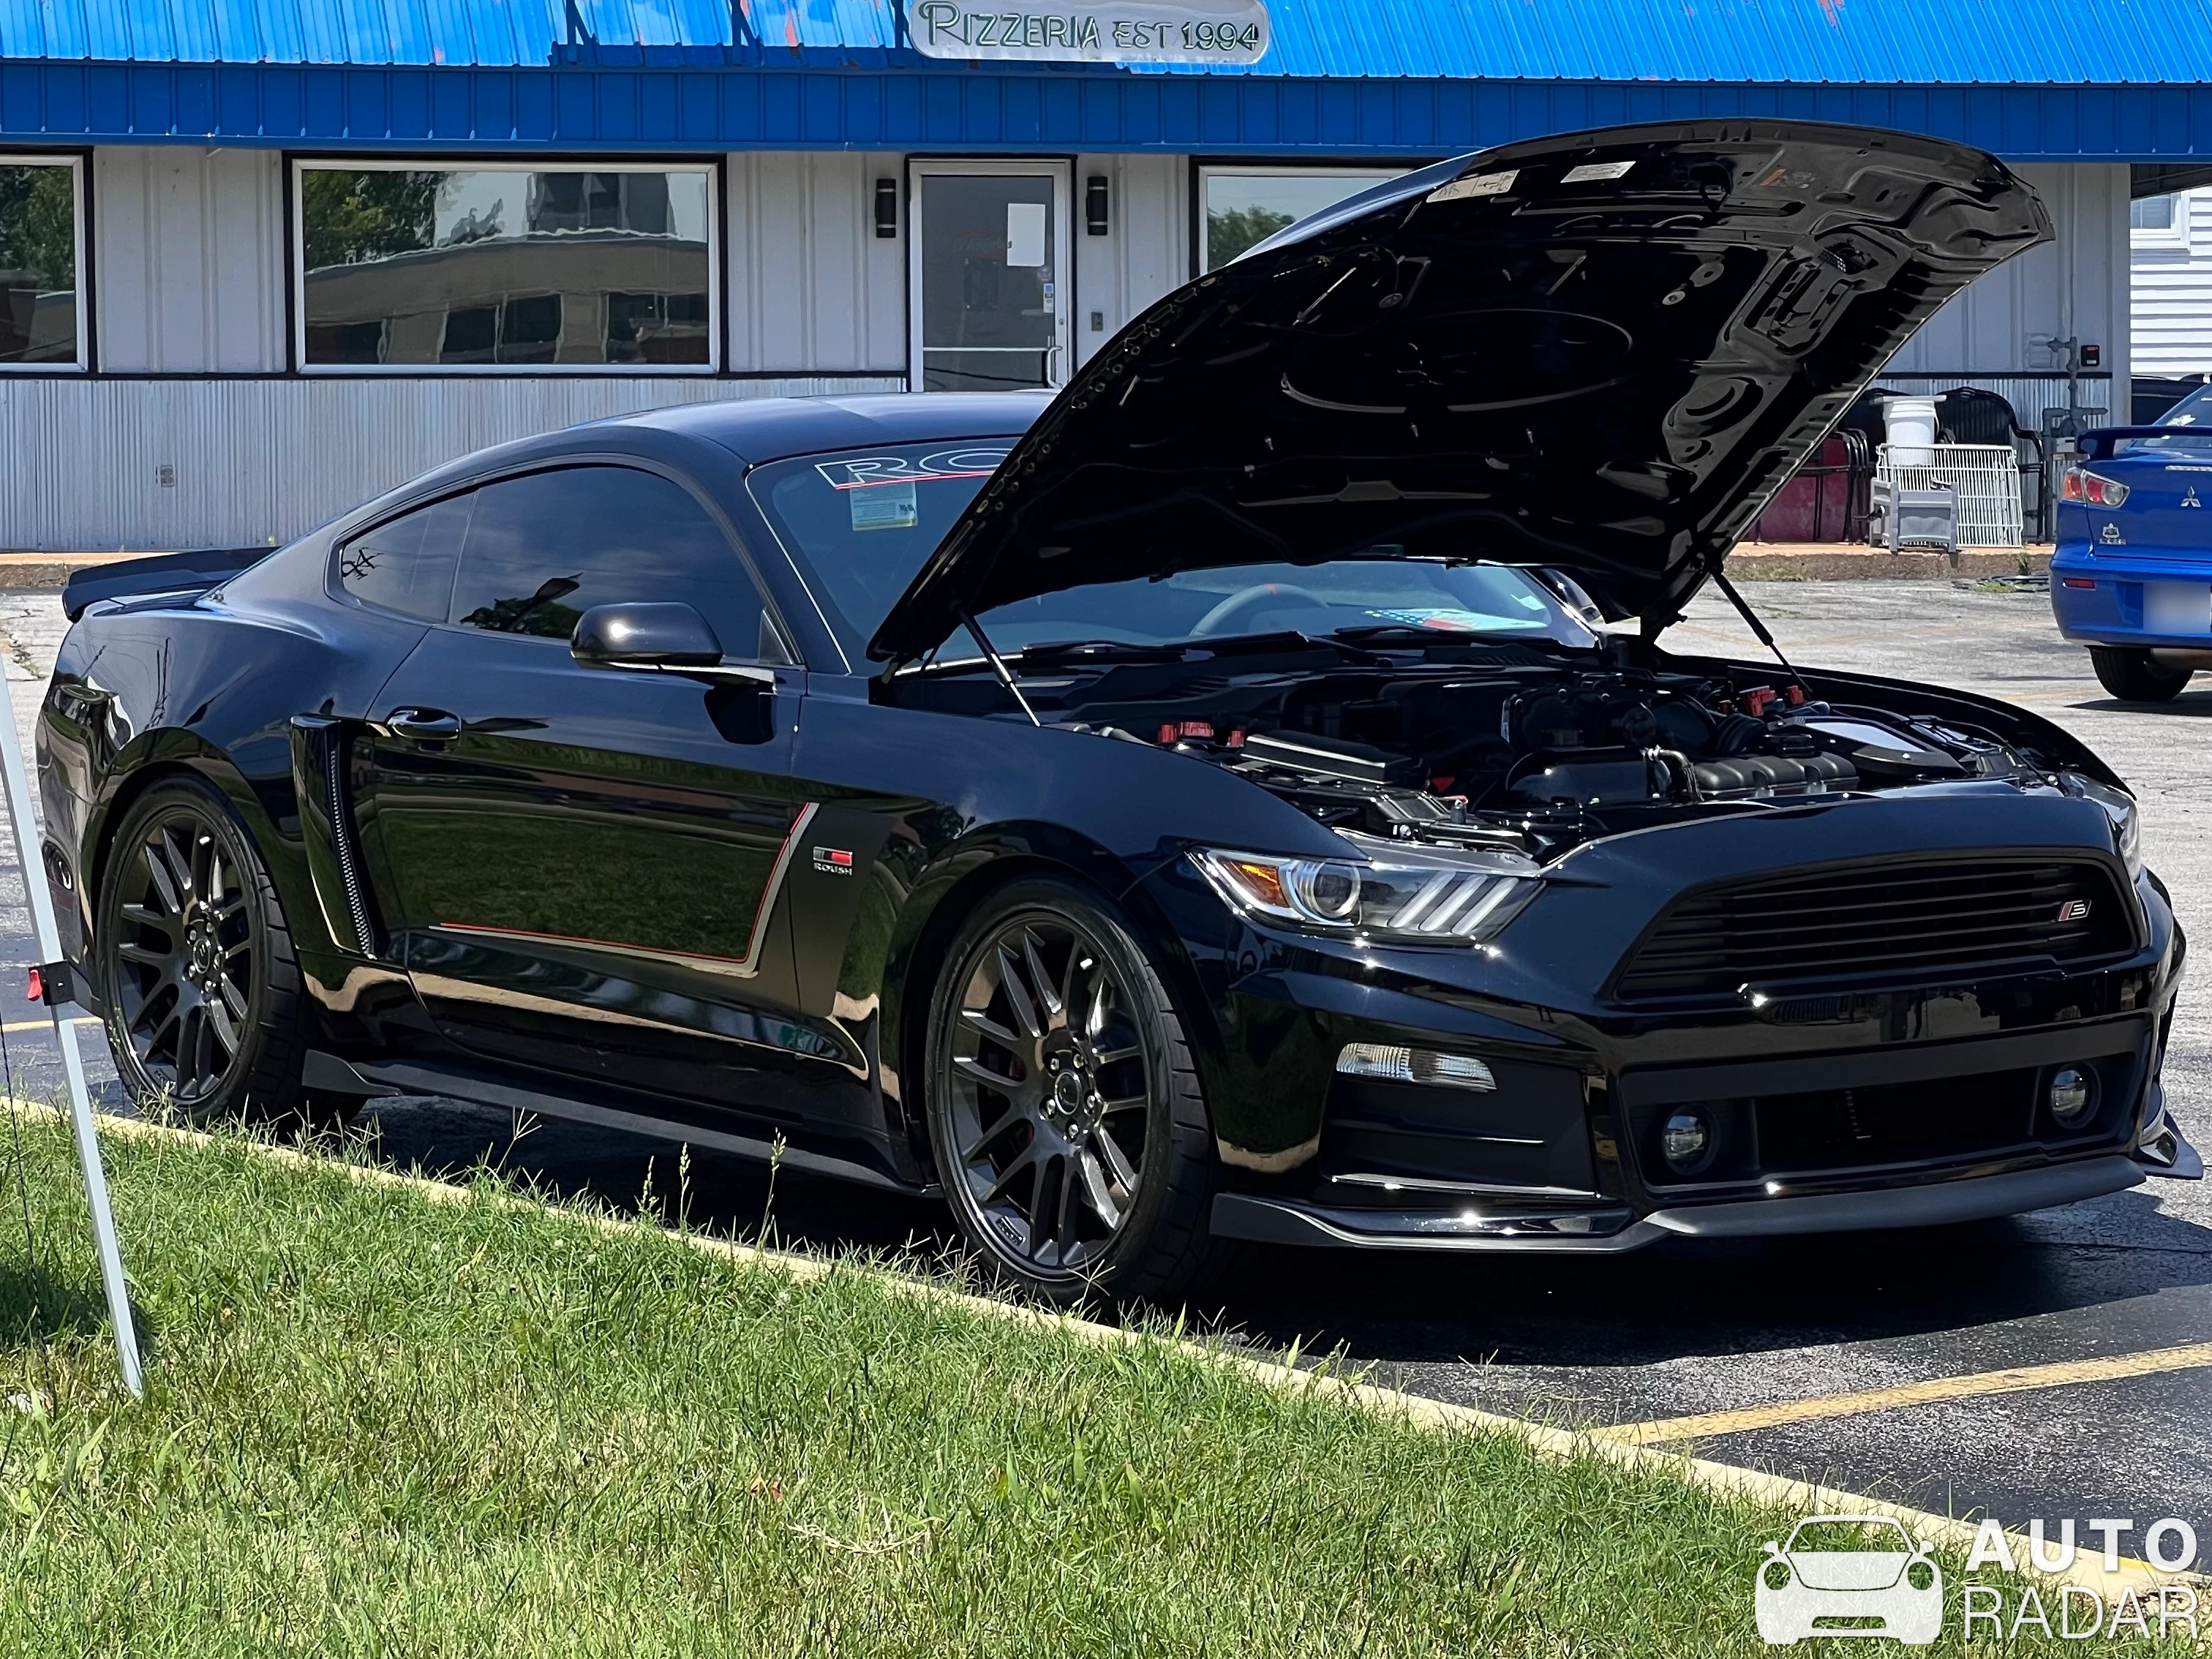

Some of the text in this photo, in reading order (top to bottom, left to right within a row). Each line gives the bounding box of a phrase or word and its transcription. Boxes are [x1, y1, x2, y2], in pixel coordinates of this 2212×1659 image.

[1112, 21, 1173, 48] EST
[1181, 21, 1259, 51] 1994
[814, 863, 852, 876] ROUSH
